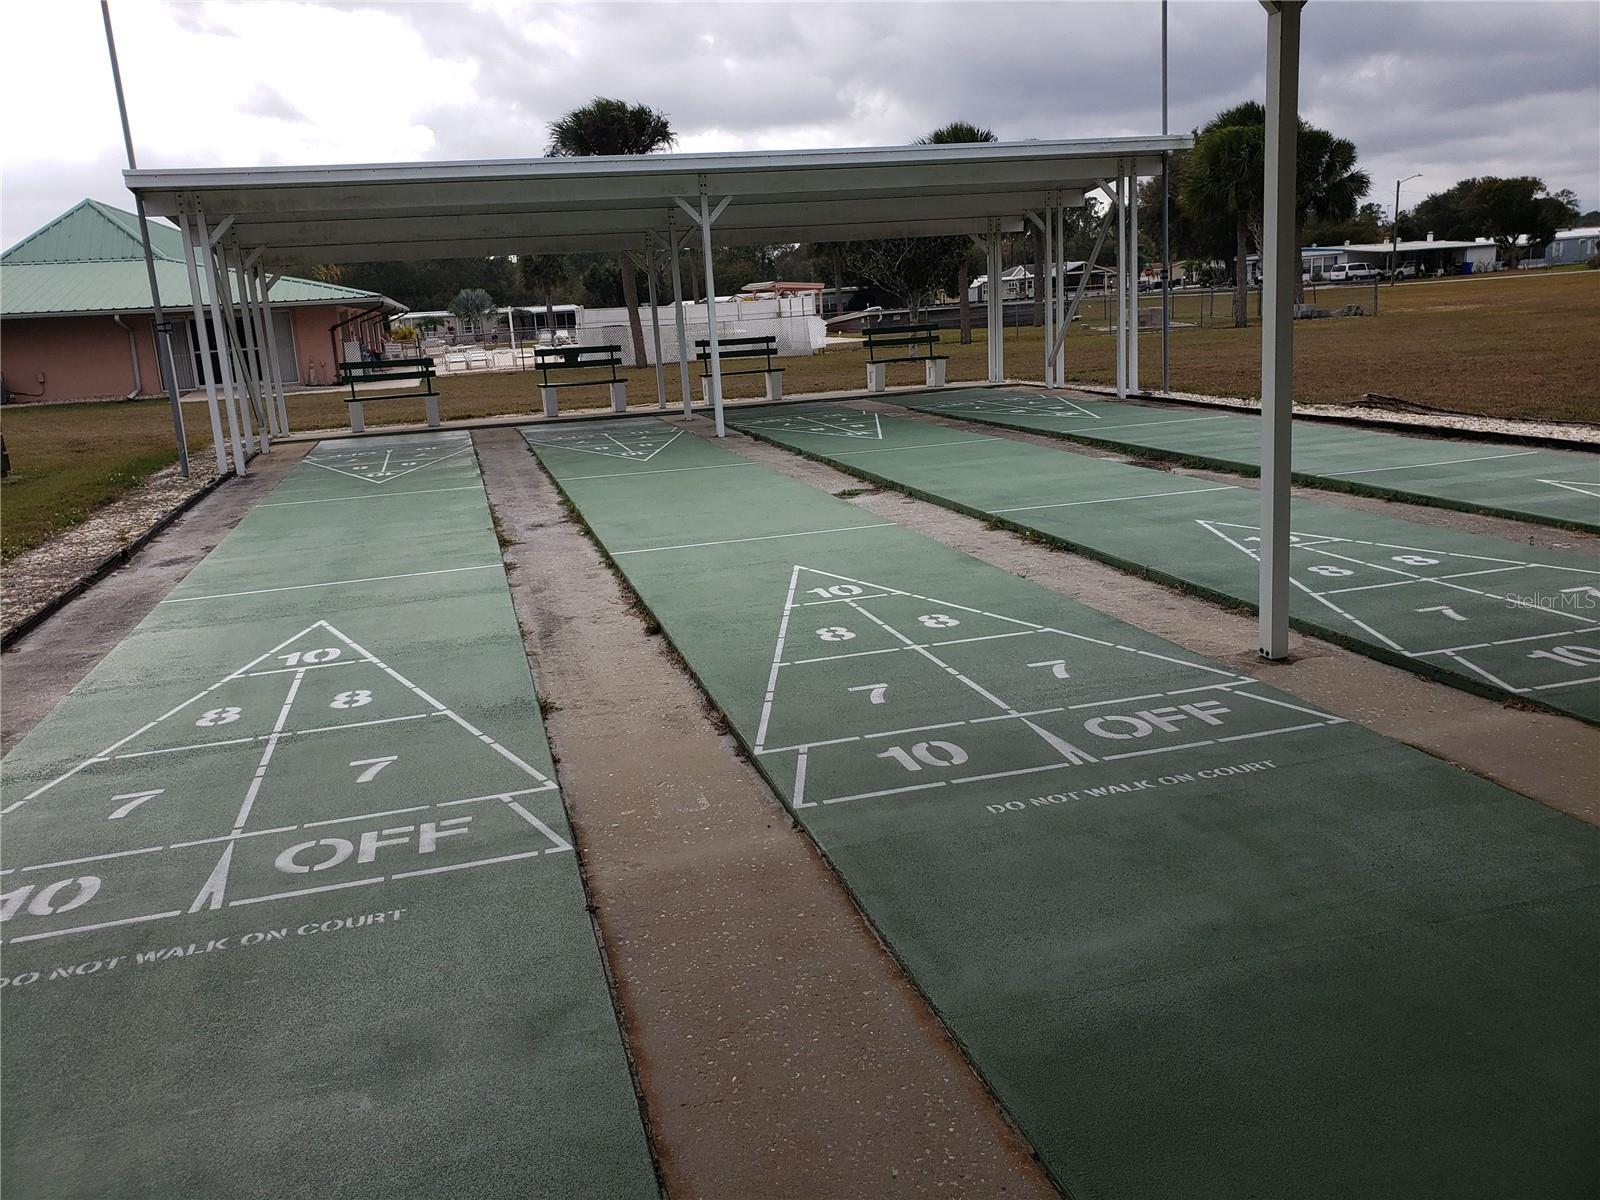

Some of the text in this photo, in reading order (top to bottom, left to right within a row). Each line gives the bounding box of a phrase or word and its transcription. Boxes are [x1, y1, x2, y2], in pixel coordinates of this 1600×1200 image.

[1307, 565, 1354, 577] 8
[1391, 554, 1440, 566] 8
[806, 583, 864, 600] 10
[918, 613, 960, 629] 8
[1416, 605, 1469, 621] 7
[815, 625, 856, 641] 8
[279, 647, 341, 667] 10
[1526, 645, 1600, 667] 10
[1027, 658, 1069, 680] 7
[329, 689, 373, 709] 8
[848, 683, 888, 706] 7
[195, 706, 242, 728] 8
[876, 700, 1231, 772] 10 OFF
[349, 755, 398, 784] 7
[986, 758, 1278, 815] DO NOT WALK ON COURT
[107, 789, 164, 820] 7
[0, 816, 473, 922] 10 OFF
[49, 956, 127, 981] NOT
[136, 937, 229, 965] WALK
[241, 927, 288, 947] ON
[297, 909, 407, 936] COURT
